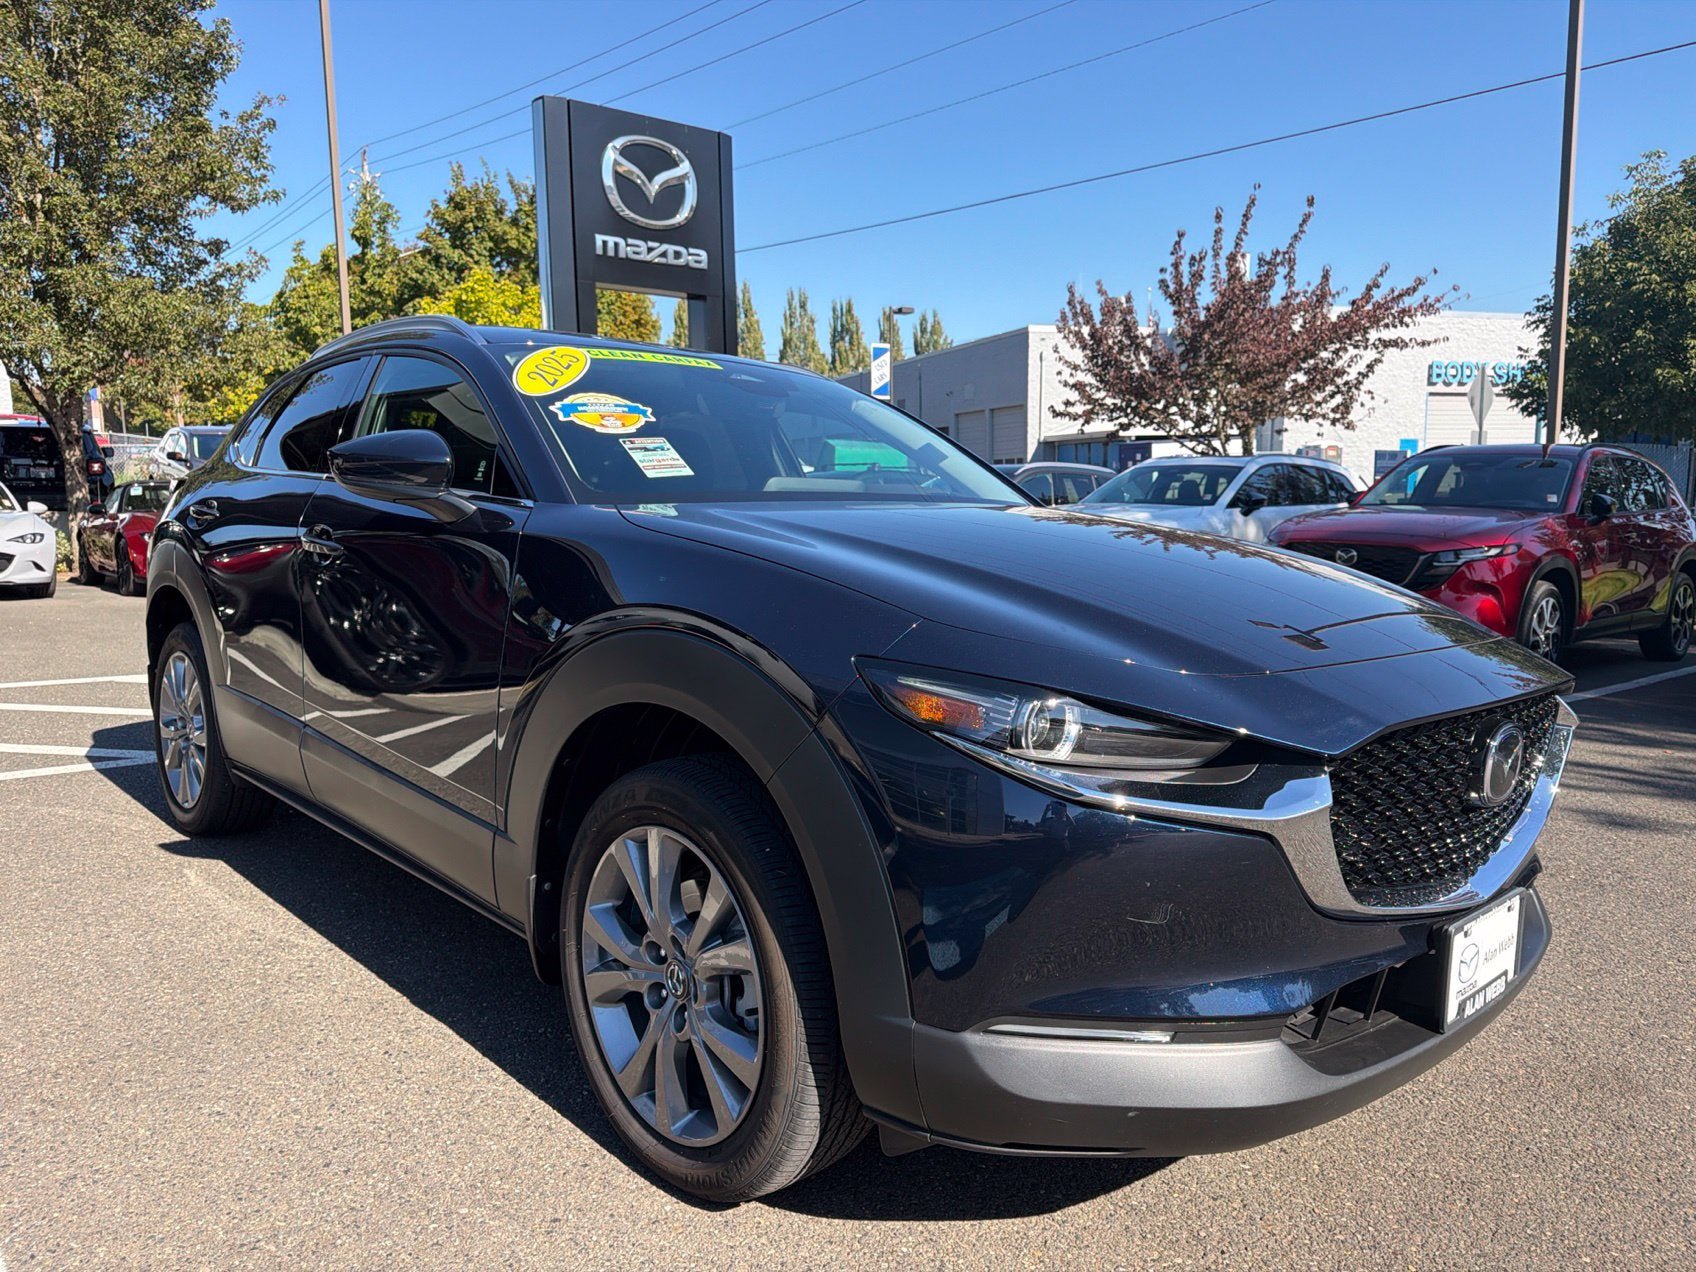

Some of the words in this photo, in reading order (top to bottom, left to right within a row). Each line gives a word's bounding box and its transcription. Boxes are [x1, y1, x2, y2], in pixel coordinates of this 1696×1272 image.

[595, 233, 708, 270] mazda
[527, 350, 580, 387] 2025
[587, 349, 645, 360] CLEAN
[1464, 989, 1486, 1019] ALAN
[1485, 975, 1506, 1004] WEBB
